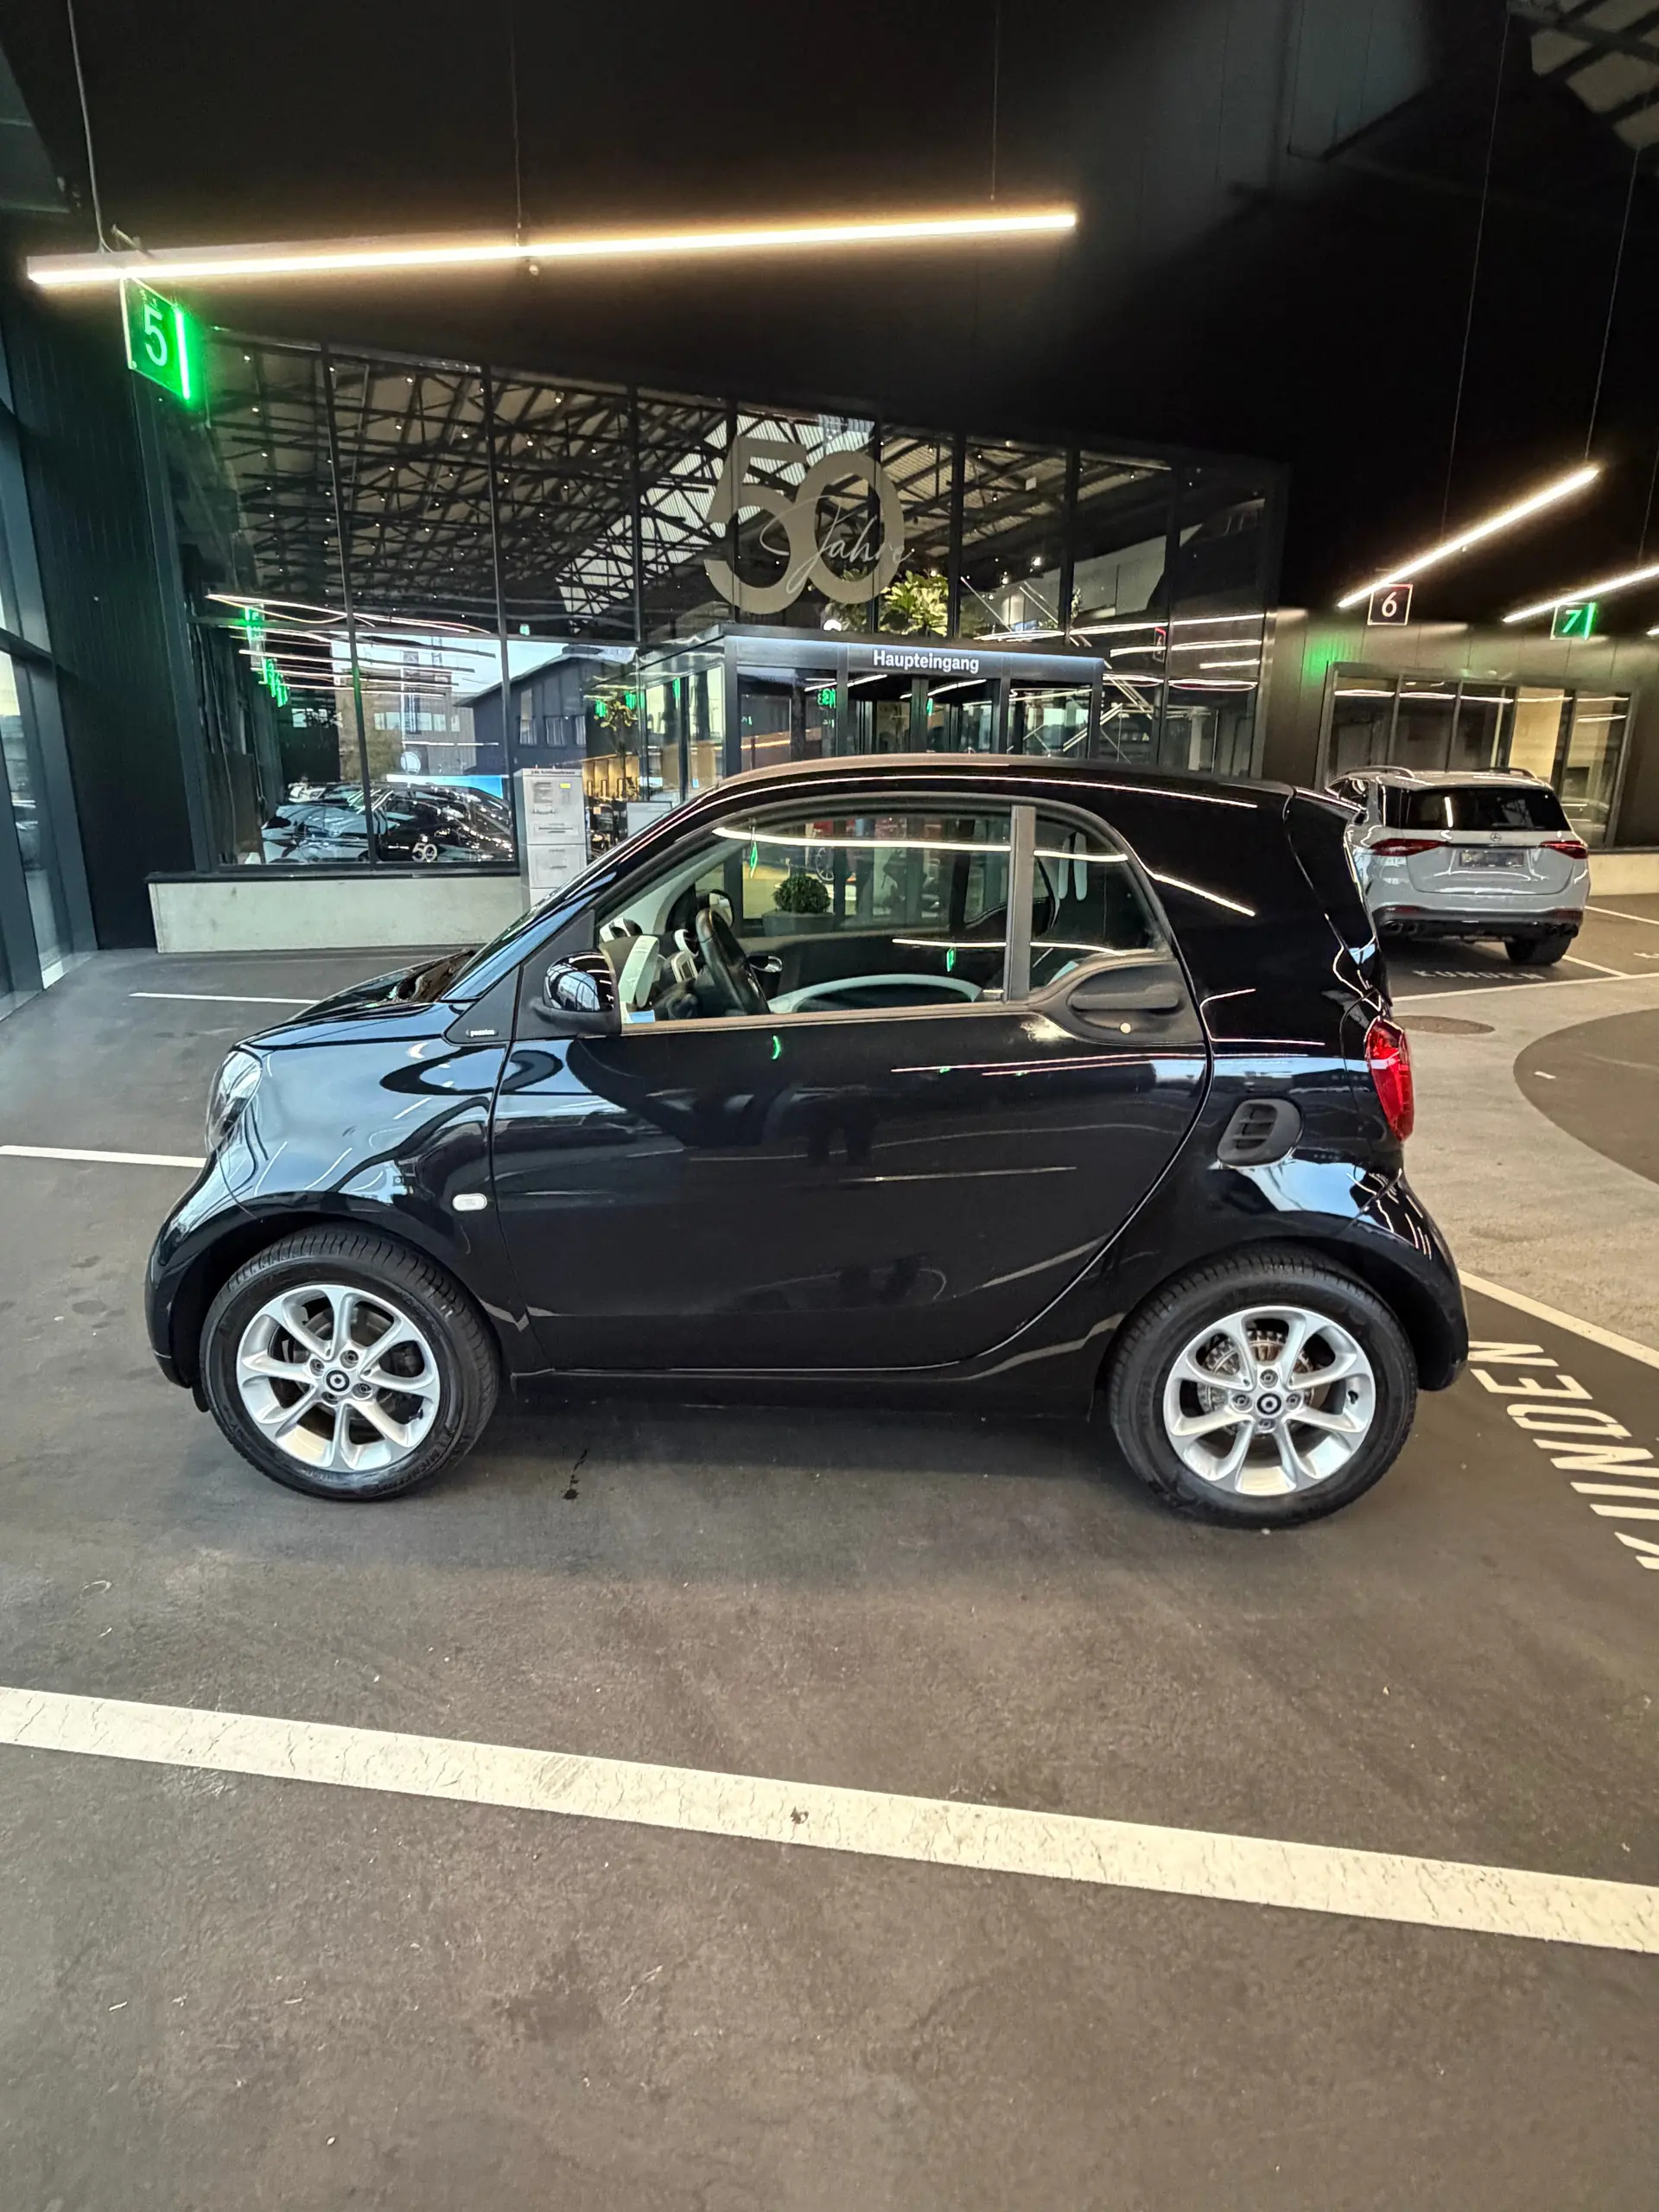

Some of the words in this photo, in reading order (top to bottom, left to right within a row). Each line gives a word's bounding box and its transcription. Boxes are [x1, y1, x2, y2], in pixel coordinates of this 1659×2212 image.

[144, 304, 167, 366] 5
[703, 435, 906, 614] 50
[760, 494, 914, 595] Jahre
[1382, 591, 1397, 618] 6
[1562, 609, 1582, 633] 7
[873, 649, 979, 674] Haupteingang
[1413, 969, 1546, 981] KUNDEN
